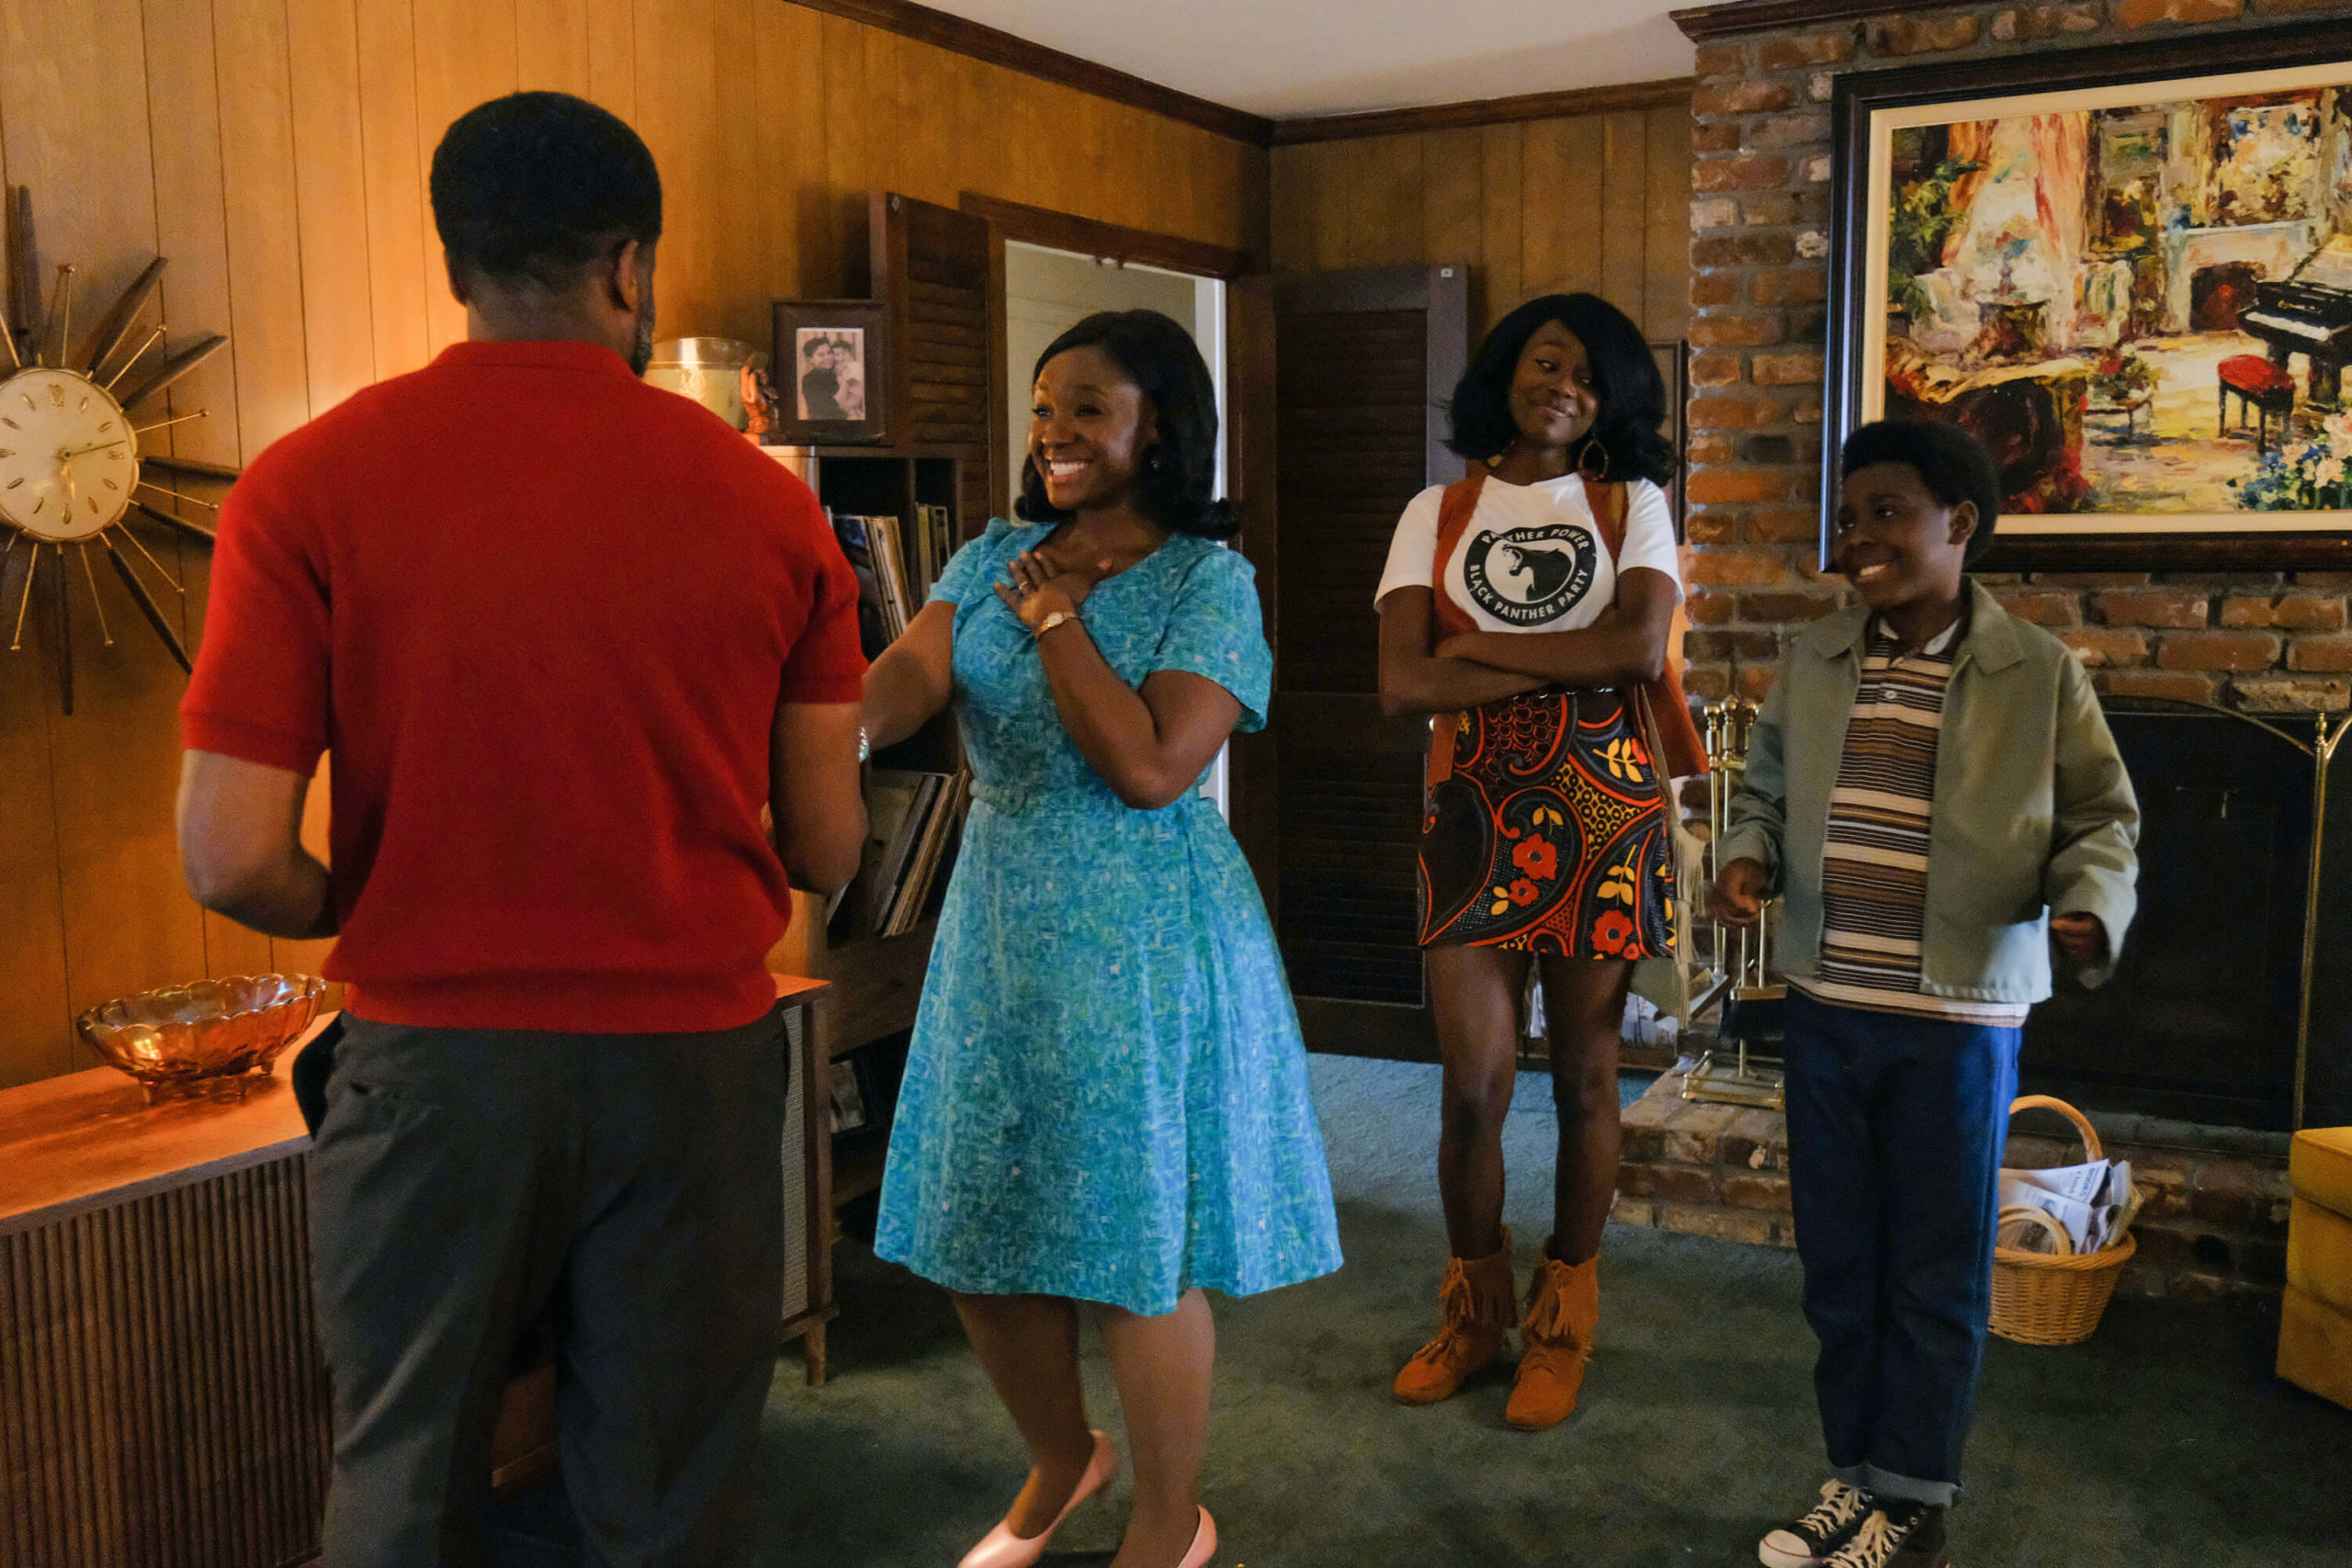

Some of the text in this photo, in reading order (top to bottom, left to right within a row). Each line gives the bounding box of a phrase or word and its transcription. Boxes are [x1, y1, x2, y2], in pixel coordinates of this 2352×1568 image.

[1550, 528, 1589, 549] POWER
[1470, 564, 1588, 620] BLACK PANTHER PARTY
